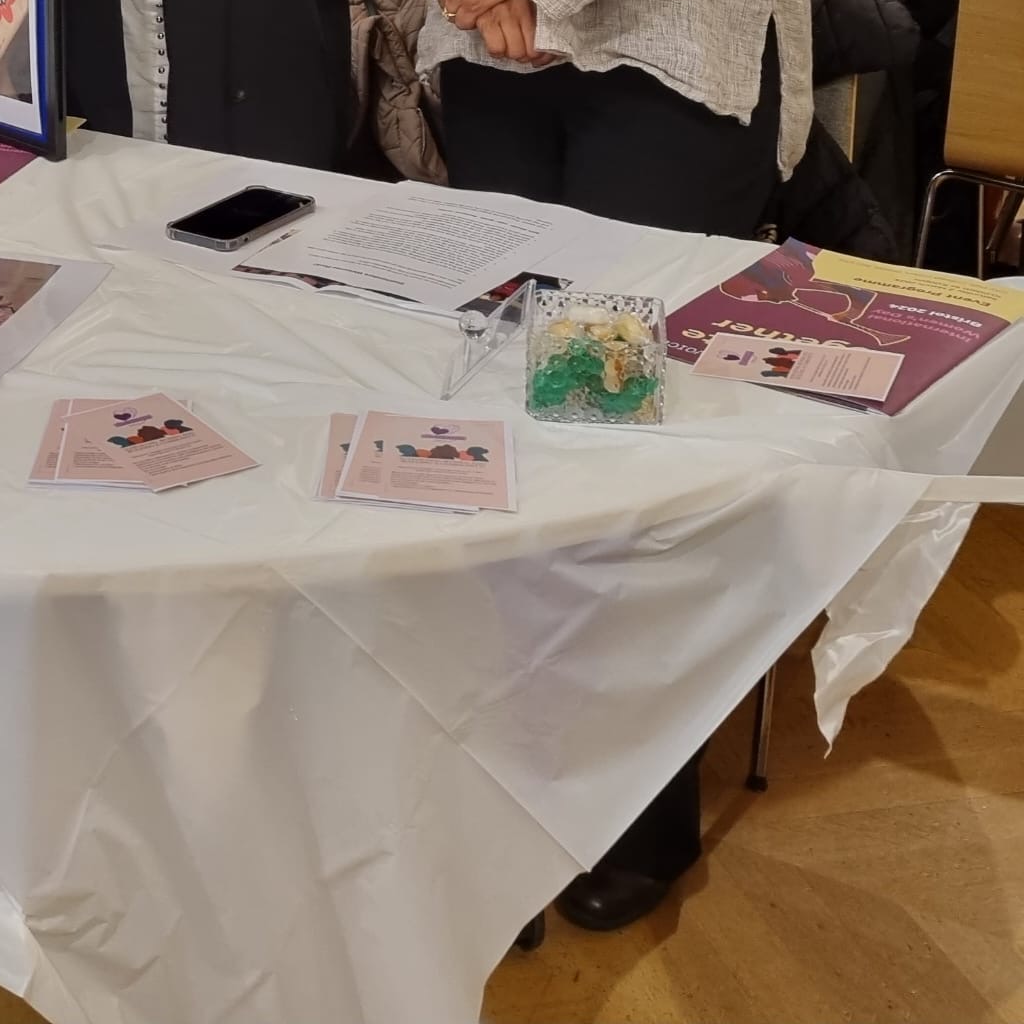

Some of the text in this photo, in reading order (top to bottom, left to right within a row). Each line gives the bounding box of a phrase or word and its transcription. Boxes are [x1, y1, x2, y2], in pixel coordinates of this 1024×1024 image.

[852, 276, 992, 308] Event Programme
[867, 313, 975, 343] International
[888, 302, 984, 328] Bristol 2024
[904, 313, 981, 339] Women's
